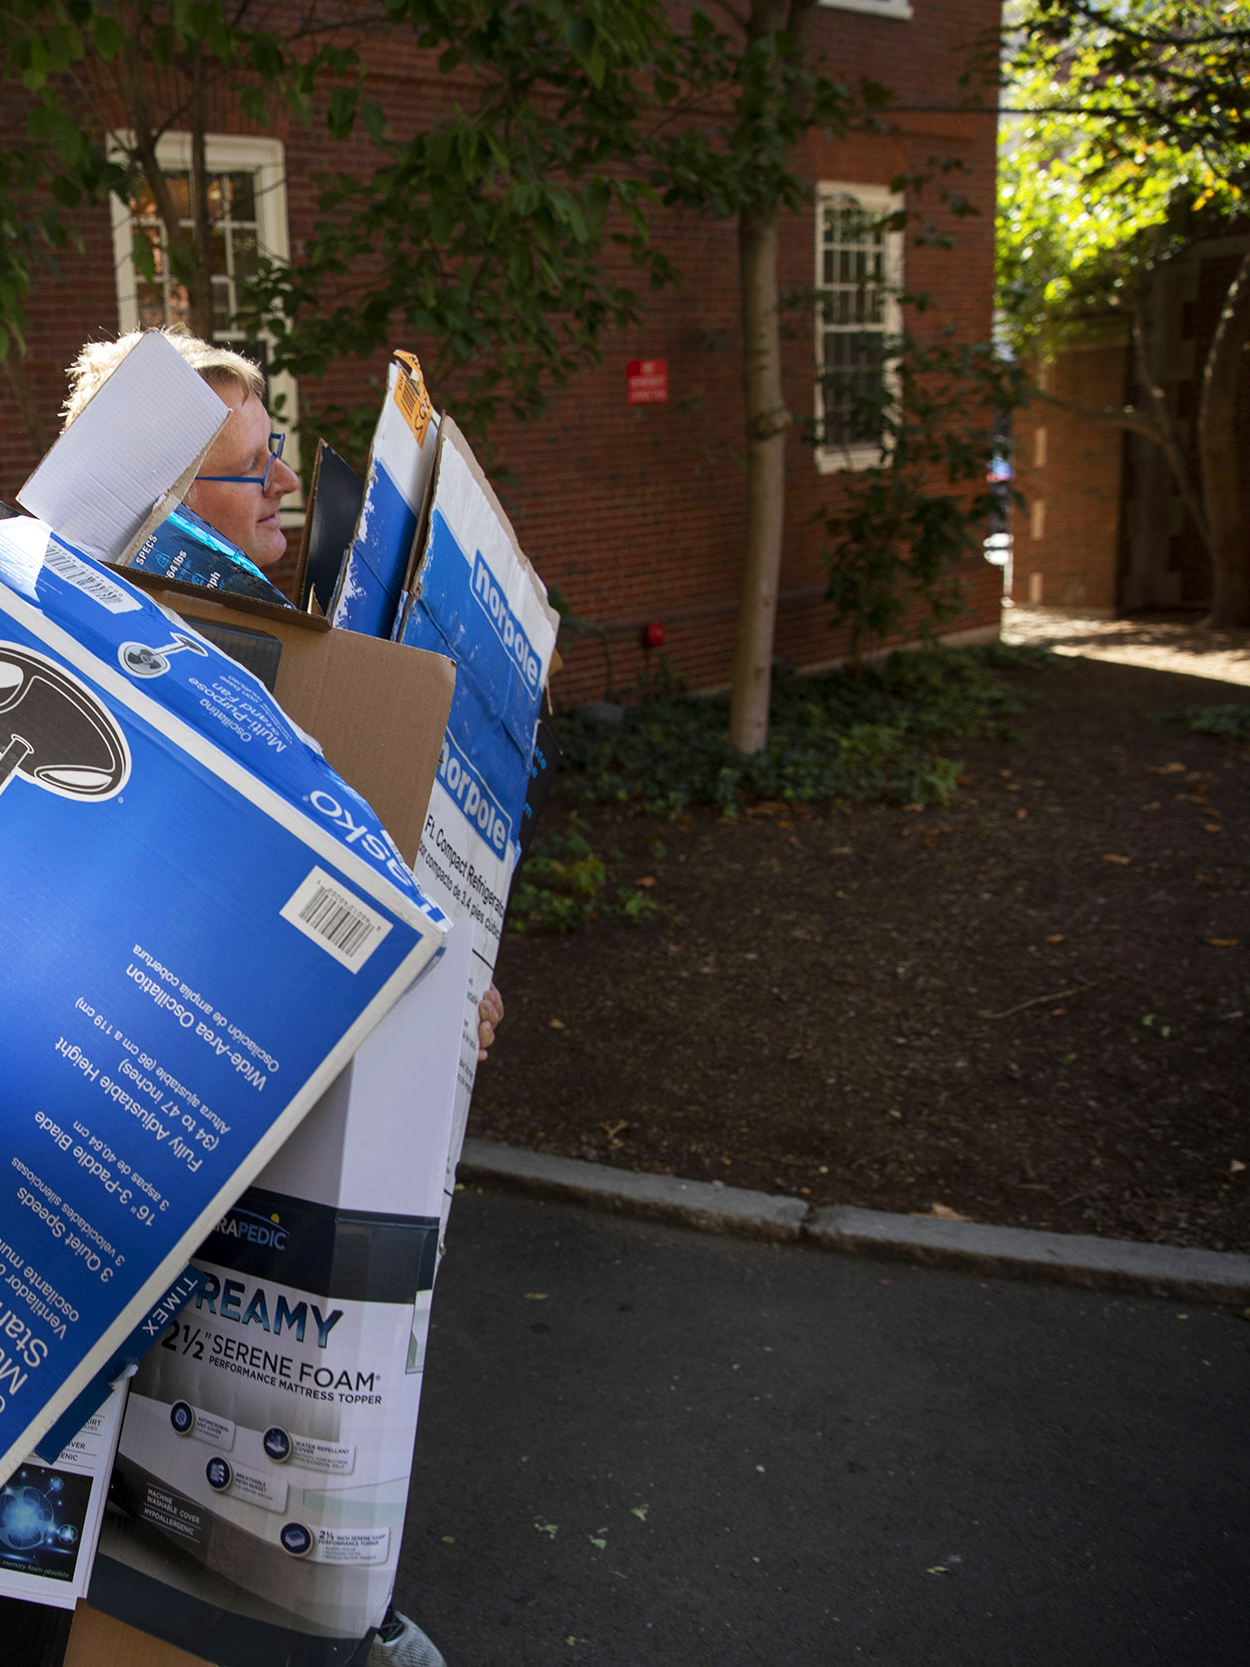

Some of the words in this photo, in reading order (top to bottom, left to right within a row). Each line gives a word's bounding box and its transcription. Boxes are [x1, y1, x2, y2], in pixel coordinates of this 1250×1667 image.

[134, 534, 159, 565] SPECS
[163, 563, 179, 580] 64
[171, 548, 187, 566] lbs
[475, 560, 539, 686] norpole
[210, 681, 240, 704] Fan
[189, 678, 287, 754] Multi-Purpose
[198, 695, 253, 744] Oscillating
[424, 814, 434, 838] Ft.
[436, 828, 468, 876] Compact
[425, 852, 451, 887] compacto
[452, 884, 462, 898] de
[468, 903, 484, 922] pies
[130, 942, 182, 988] cobertura
[73, 996, 98, 1018] cm)
[126, 961, 198, 1030] Oscillation
[176, 980, 217, 1015] amplia
[93, 1014, 114, 1035] 119
[111, 1029, 124, 1041] a
[209, 1010, 229, 1028] de
[55, 1037, 104, 1081] Height
[120, 1037, 141, 1056] cm
[135, 1050, 159, 1071] (86
[196, 1022, 271, 1091] Wide-Area
[223, 1022, 282, 1074] Oscilación
[118, 1059, 166, 1103] inches)
[152, 1064, 202, 1110] ajustable
[100, 1076, 172, 1143] Adjustable
[161, 1099, 183, 1119] 47
[178, 1112, 199, 1132] to
[194, 1105, 231, 1136] Altura
[29, 1108, 74, 1150] Blade
[70, 1119, 91, 1138] cm
[193, 1127, 222, 1152] (34
[86, 1133, 119, 1164] 40,64
[168, 1136, 203, 1172] Fully
[8, 1155, 63, 1207] silenciosas
[71, 1145, 135, 1204] 3-Paddle
[114, 1158, 132, 1176] de
[128, 1169, 164, 1203] aspas
[17, 1187, 65, 1237] Speeds
[131, 1203, 155, 1226] 16"
[157, 1198, 171, 1212] 3
[57, 1202, 118, 1259] velocidades
[61, 1231, 104, 1272] Quiet
[113, 1253, 127, 1267] 3
[97, 1265, 115, 1283] 3
[3, 1272, 70, 1339] Ventilador
[23, 1264, 81, 1323] oscilante
[142, 1278, 198, 1336] TIMEX
[212, 1334, 292, 1378] SERENE
[209, 1355, 277, 1388] PERFORMANCE
[278, 1380, 334, 1402] MATTRESS
[338, 1393, 382, 1406] TOPPER
[294, 1440, 316, 1449] WATER
[316, 1445, 348, 1454] REPELLANT
[294, 1446, 314, 1454] COVER
[146, 1496, 176, 1514] WASHABLE
[178, 1510, 201, 1523] COVER
[147, 1488, 171, 1504] MACHINE
[144, 1507, 194, 1534] HYPOALLERGENIC
